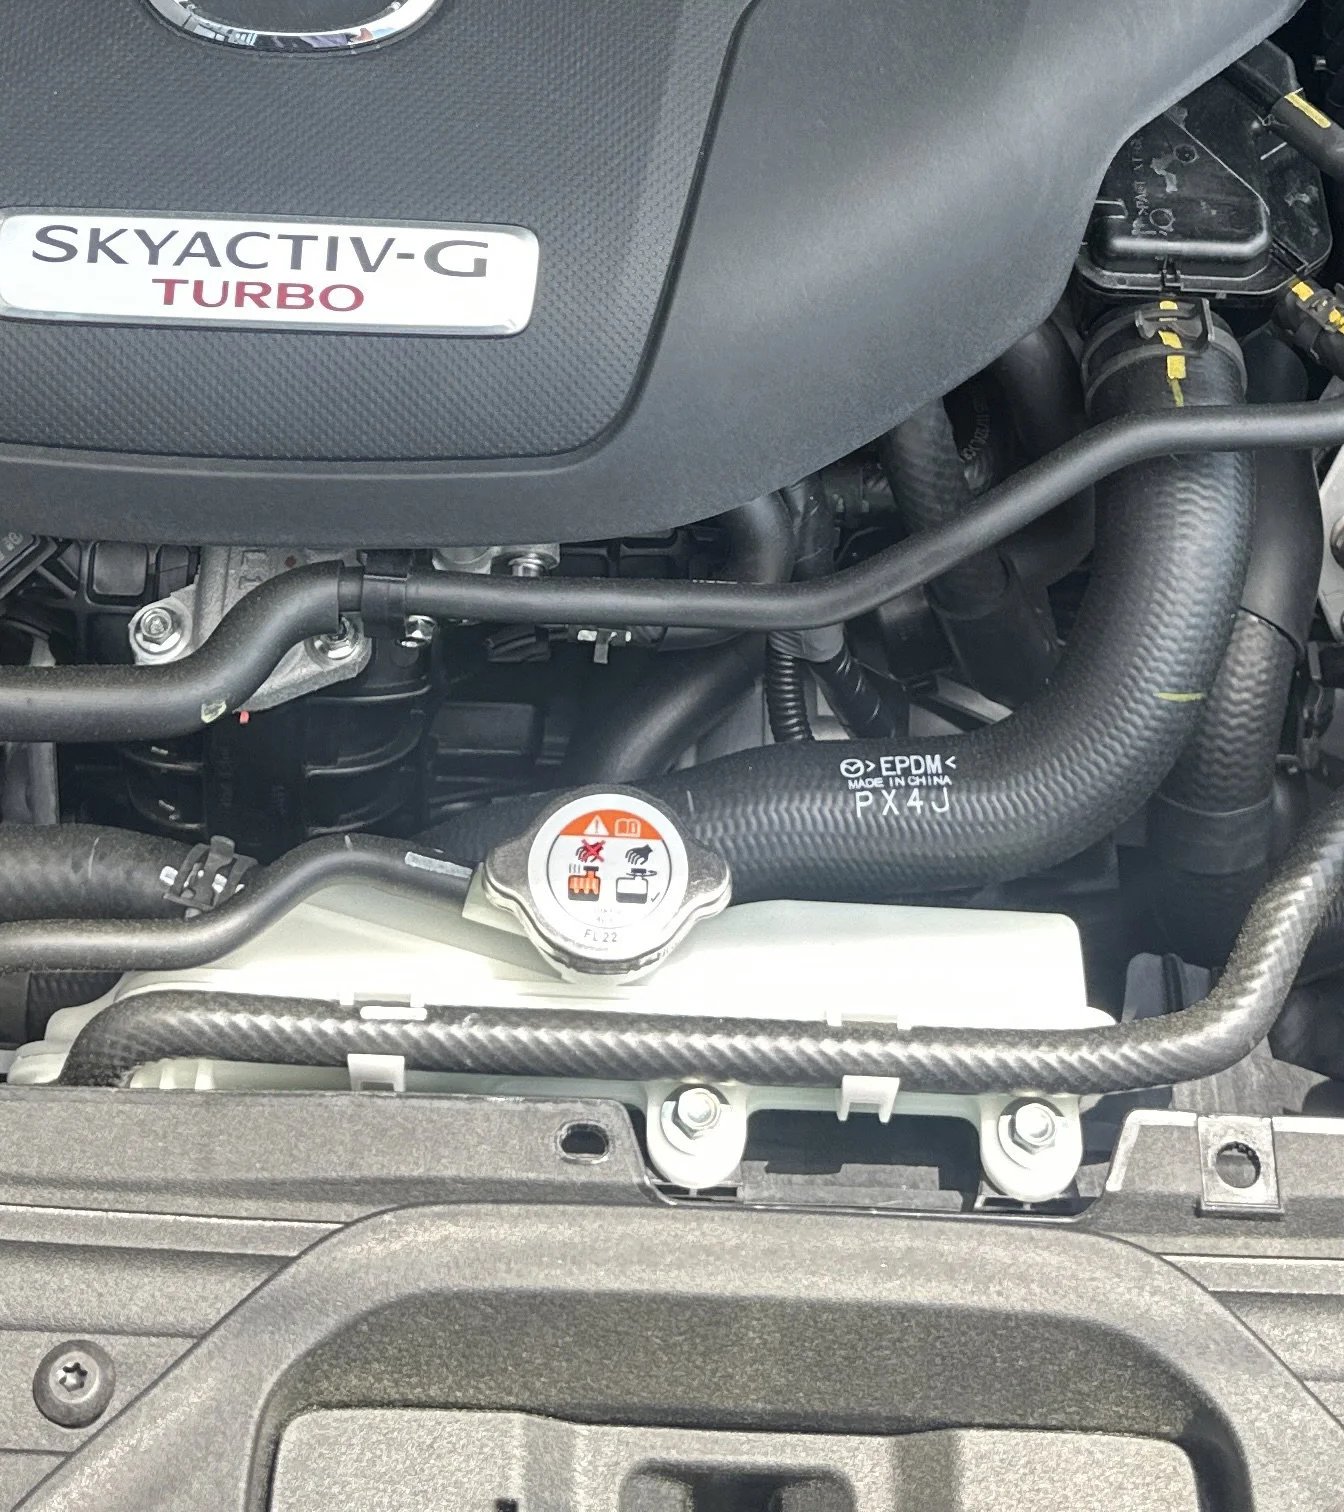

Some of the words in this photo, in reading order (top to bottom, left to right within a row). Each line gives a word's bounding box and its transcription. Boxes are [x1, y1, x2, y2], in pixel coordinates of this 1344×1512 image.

[30, 224, 490, 278] SKYACTIV-G
[150, 278, 366, 313] TURBO
[847, 777, 885, 790] MADE
[889, 776, 906, 788] IN
[907, 775, 953, 787] CHINA
[856, 787, 950, 818] PX4J
[583, 929, 618, 943] FL22
